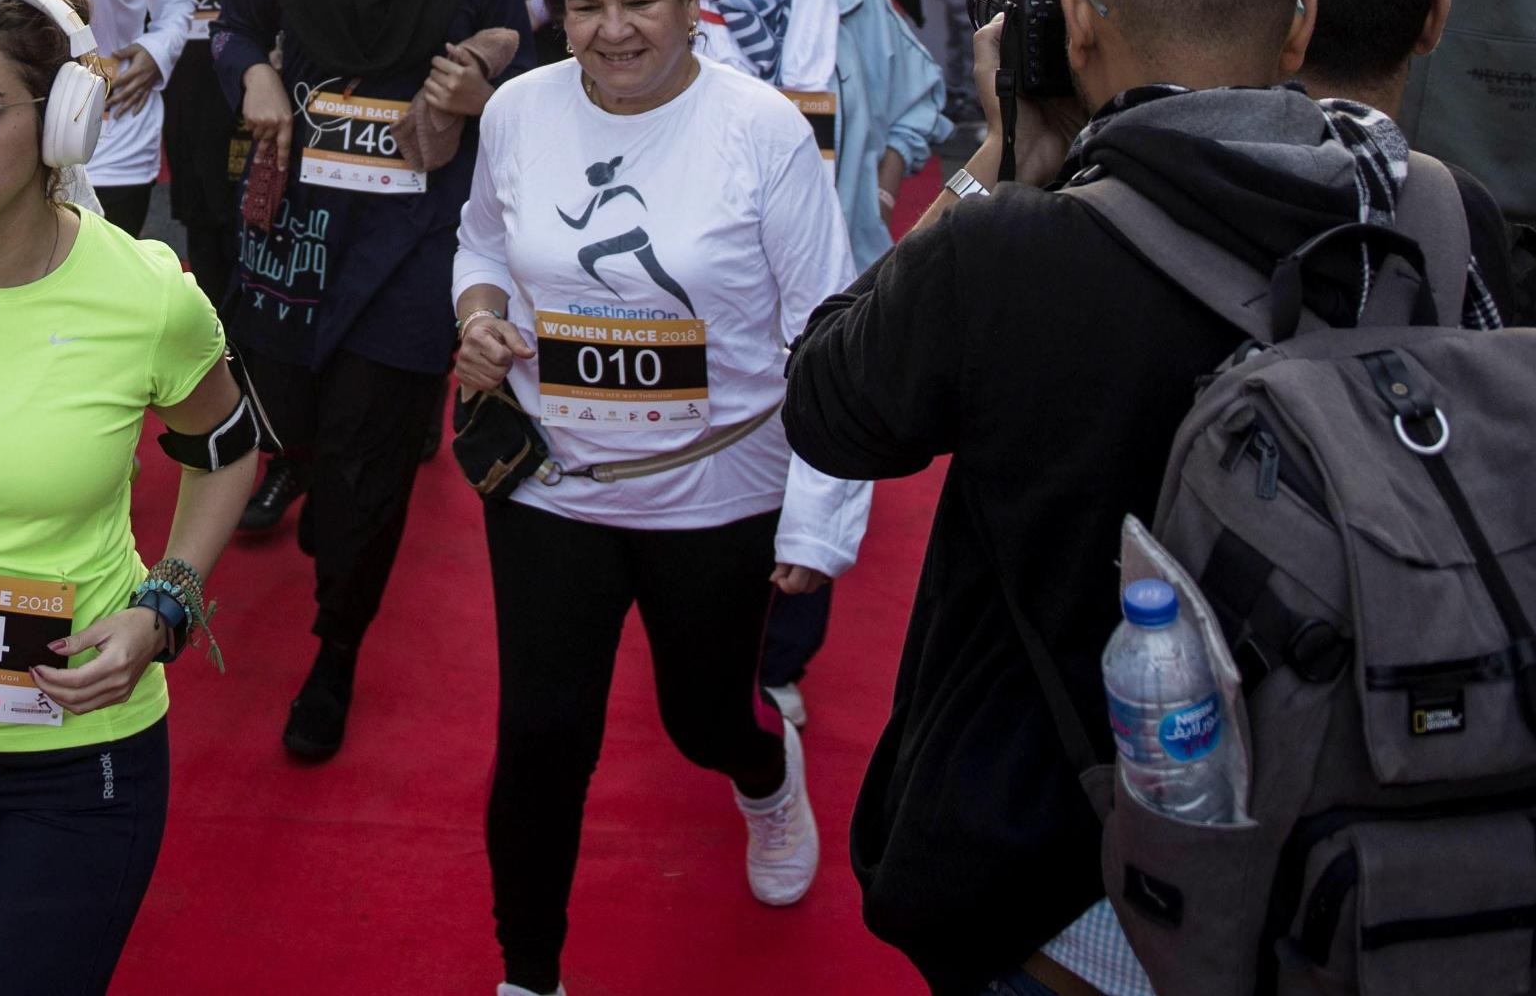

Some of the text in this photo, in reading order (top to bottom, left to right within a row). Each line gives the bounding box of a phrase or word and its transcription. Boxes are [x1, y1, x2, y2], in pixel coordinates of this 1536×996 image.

[314, 99, 400, 120] WOMEN RACE
[339, 120, 398, 156] 146
[541, 320, 697, 343] WOMEN RACE 2018
[576, 345, 663, 387] 010
[16, 594, 64, 613] 2018
[99, 752, 115, 800] Reebok
